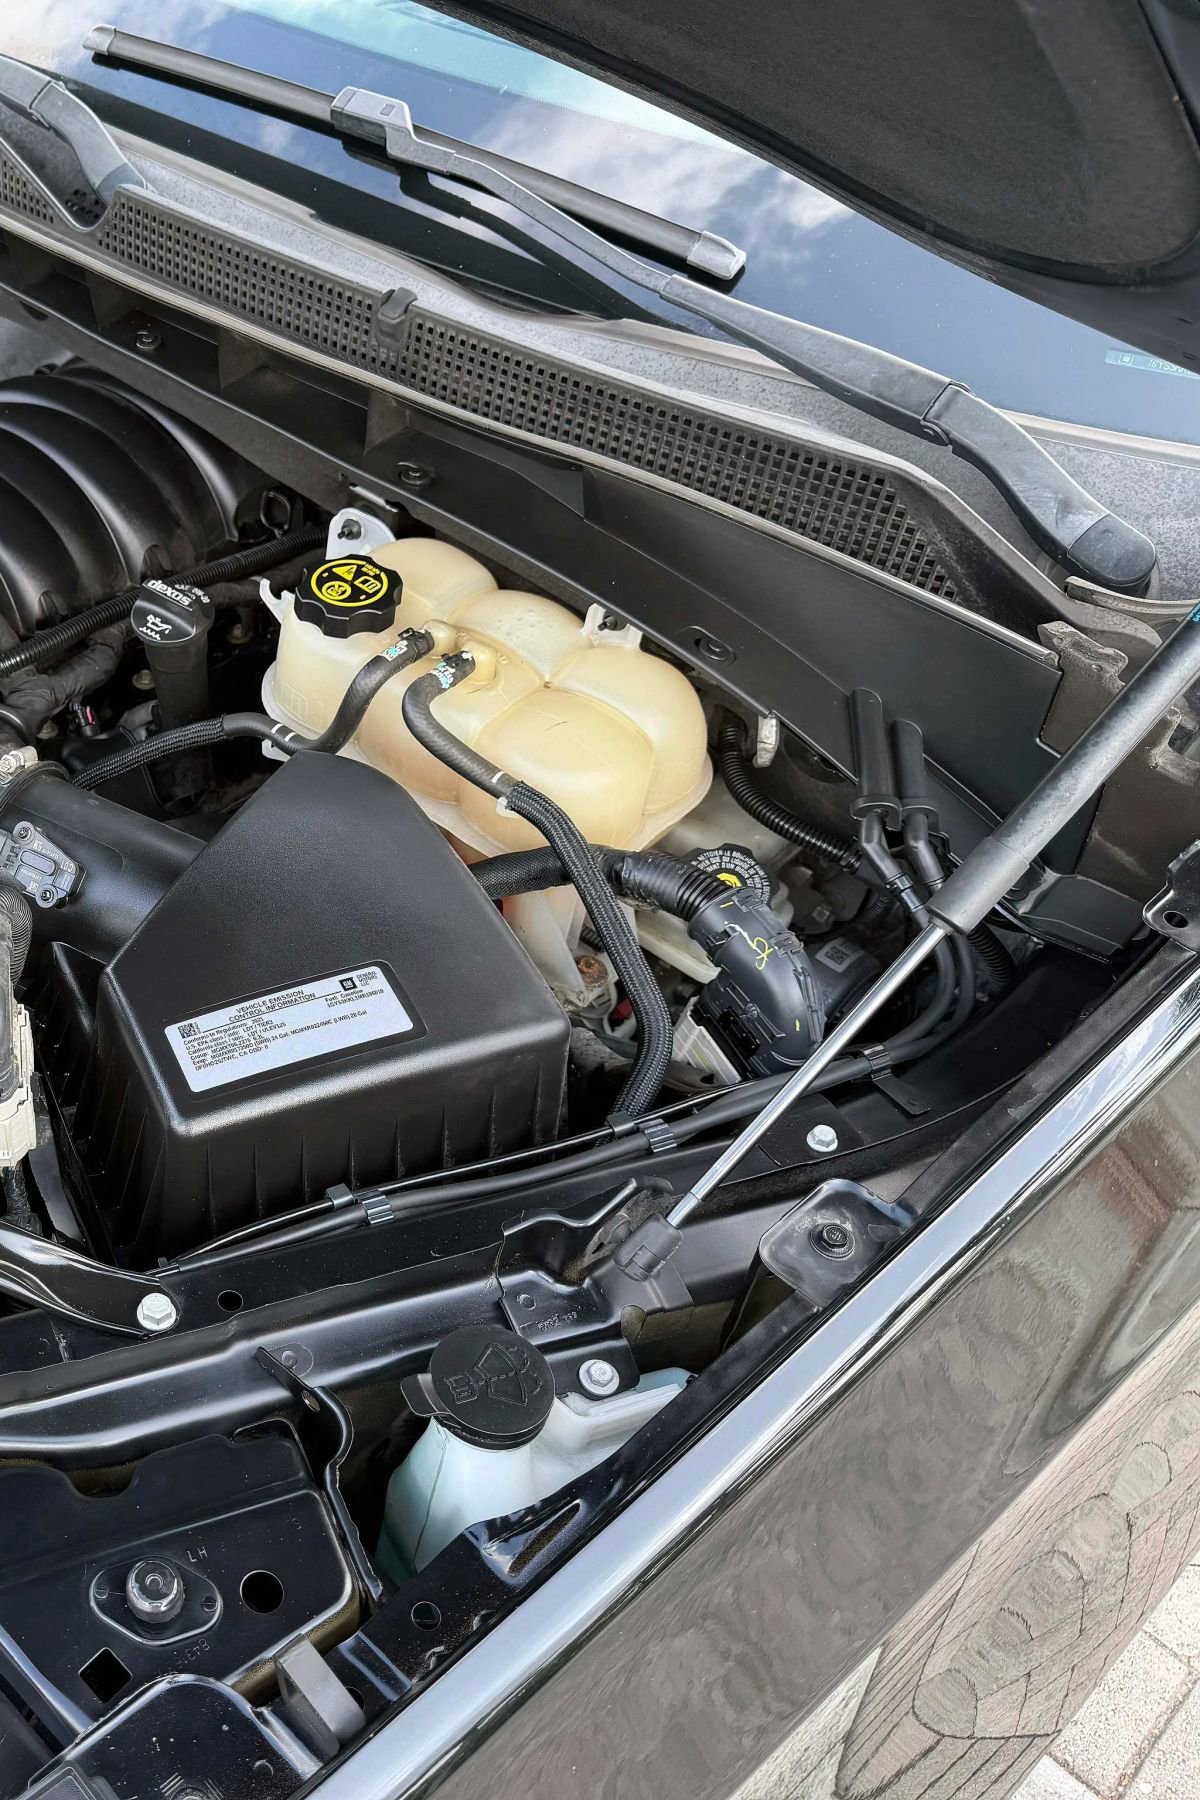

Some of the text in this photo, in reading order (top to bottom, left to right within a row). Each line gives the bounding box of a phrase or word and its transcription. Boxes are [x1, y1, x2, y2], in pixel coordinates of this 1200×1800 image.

[147, 580, 192, 605] dexos
[229, 992, 316, 1022] CONTROL INFORMATION
[236, 989, 304, 1013] VEHICLE EMISSION
[187, 1546, 208, 1563] LH
